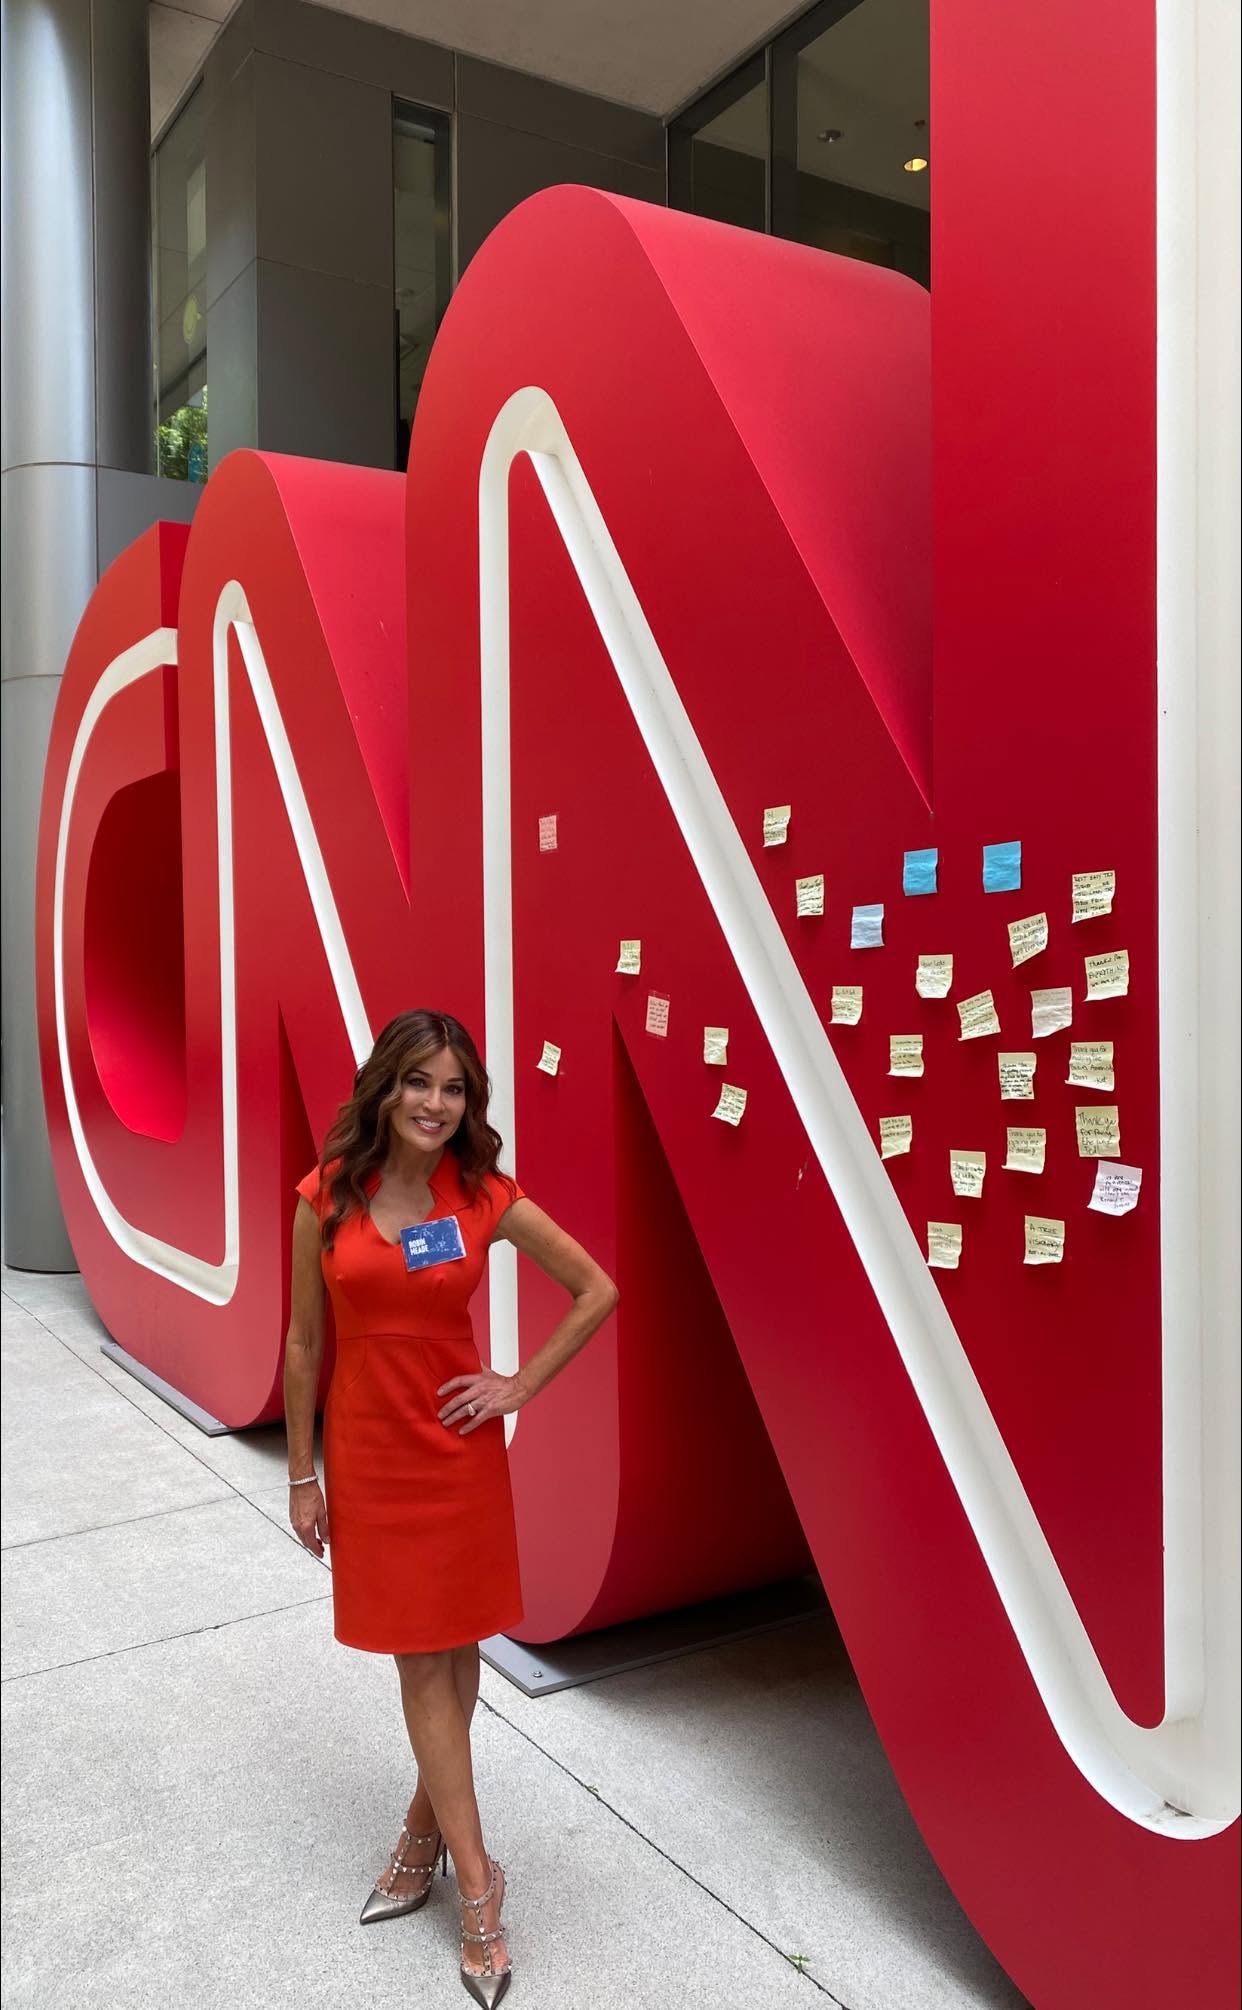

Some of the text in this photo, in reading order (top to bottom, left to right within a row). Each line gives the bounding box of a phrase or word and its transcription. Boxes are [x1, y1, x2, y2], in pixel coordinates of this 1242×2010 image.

[42, 0, 1242, 2010] CNN
[408, 1238, 426, 1248] ROBIN
[410, 1245, 429, 1256] MEADE
